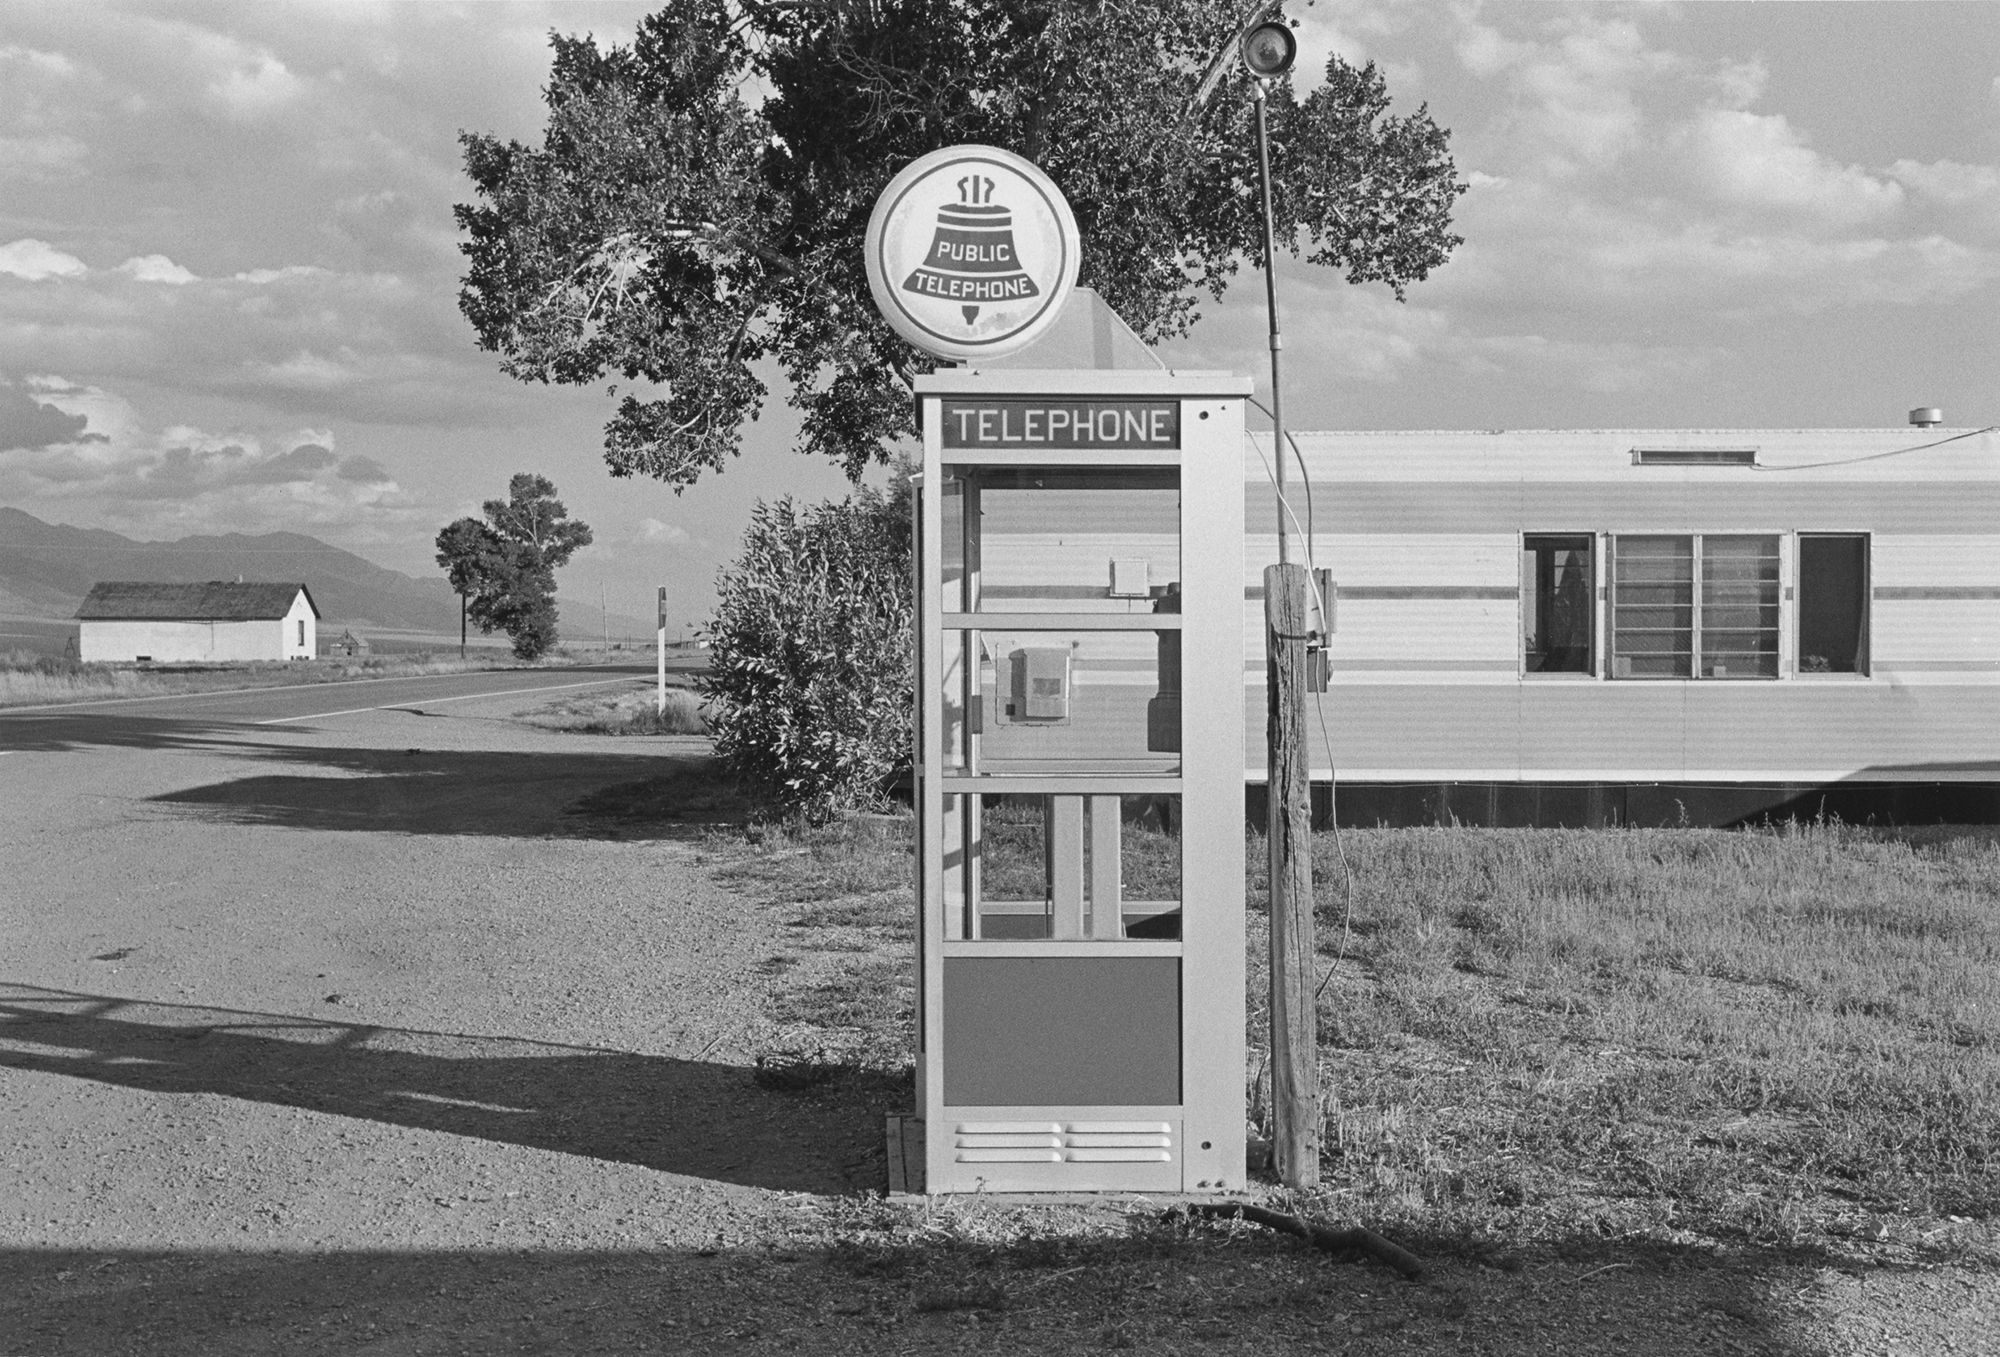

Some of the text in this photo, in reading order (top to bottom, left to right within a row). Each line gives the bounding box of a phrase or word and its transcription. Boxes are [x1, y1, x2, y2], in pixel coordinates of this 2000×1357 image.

[937, 241, 1010, 262] PUBLIC
[915, 272, 1031, 298] TELEPHONE
[952, 409, 1171, 441] TELEPHONE
